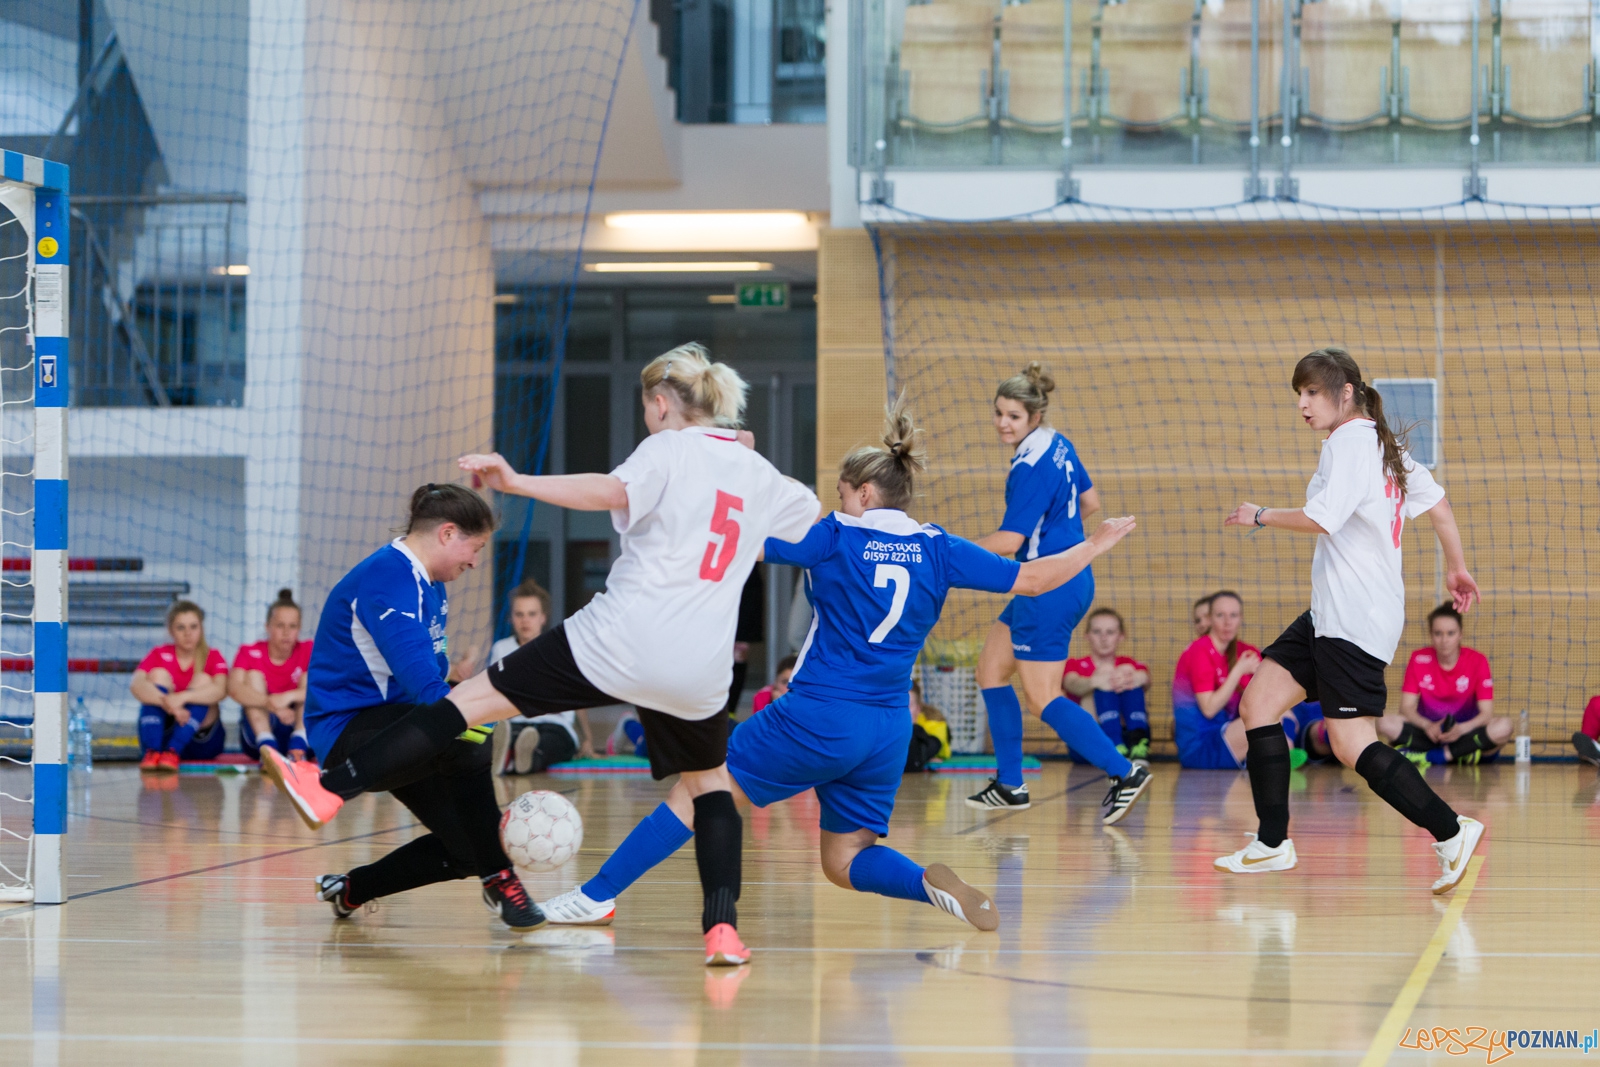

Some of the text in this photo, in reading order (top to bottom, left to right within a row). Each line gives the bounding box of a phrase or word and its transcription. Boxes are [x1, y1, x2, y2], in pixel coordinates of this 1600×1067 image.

[698, 488, 744, 583] 5
[863, 551, 922, 563] 01597 822118
[893, 543, 921, 553] TAXIS
[868, 563, 911, 644] 7
